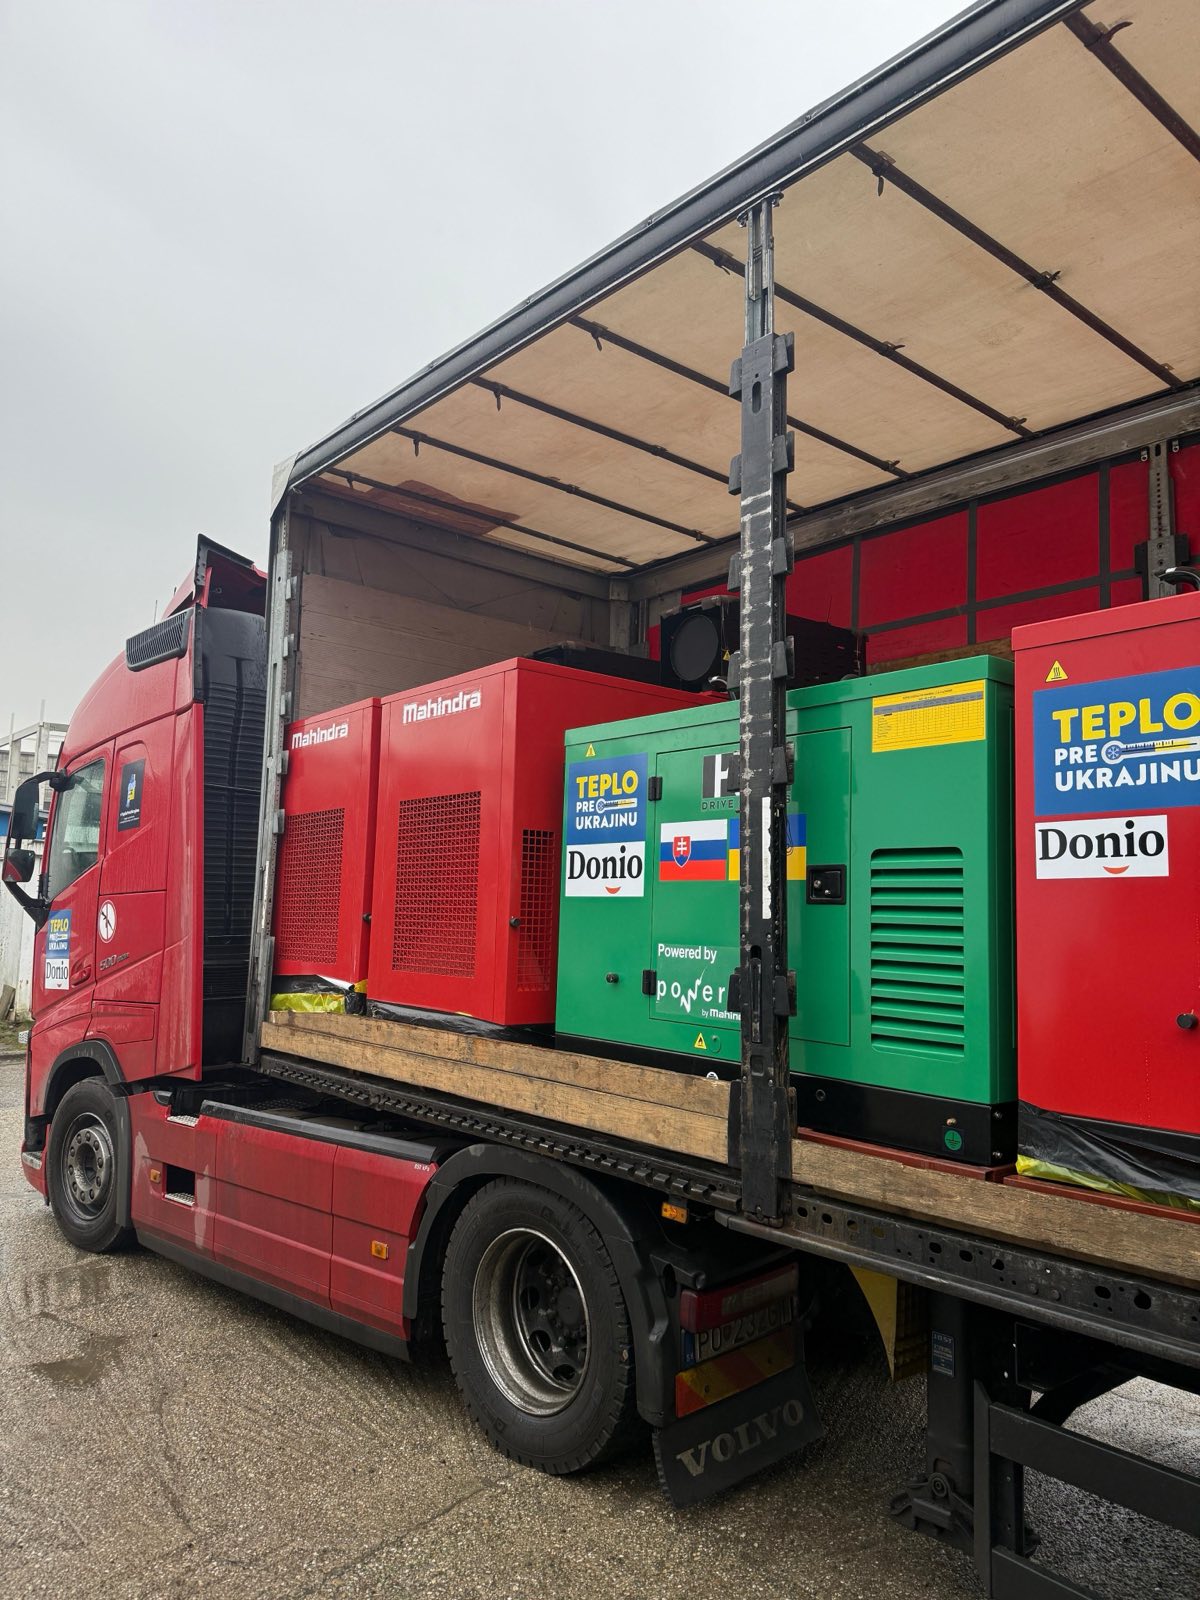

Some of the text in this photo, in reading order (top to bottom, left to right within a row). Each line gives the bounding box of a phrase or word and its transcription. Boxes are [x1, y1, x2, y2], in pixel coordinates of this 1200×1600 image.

[403, 689, 482, 724] Mahindra
[1052, 692, 1200, 743] TEPLO
[291, 722, 349, 749] Mahindra
[1054, 744, 1098, 766] PRE
[576, 770, 639, 799] TEPLO
[1055, 759, 1200, 792] UKRAJINU
[576, 800, 595, 813] PRE
[701, 799, 734, 810] DRIVE
[575, 812, 638, 830] UKRAJINU
[1038, 820, 1165, 861] Donio
[568, 845, 643, 880] Donio
[50, 918, 69, 933] TEPLO
[657, 943, 718, 964] Powered by
[46, 960, 69, 980] Donio
[701, 1008, 741, 1021] by Mahin
[676, 1399, 804, 1477] VOLVO
